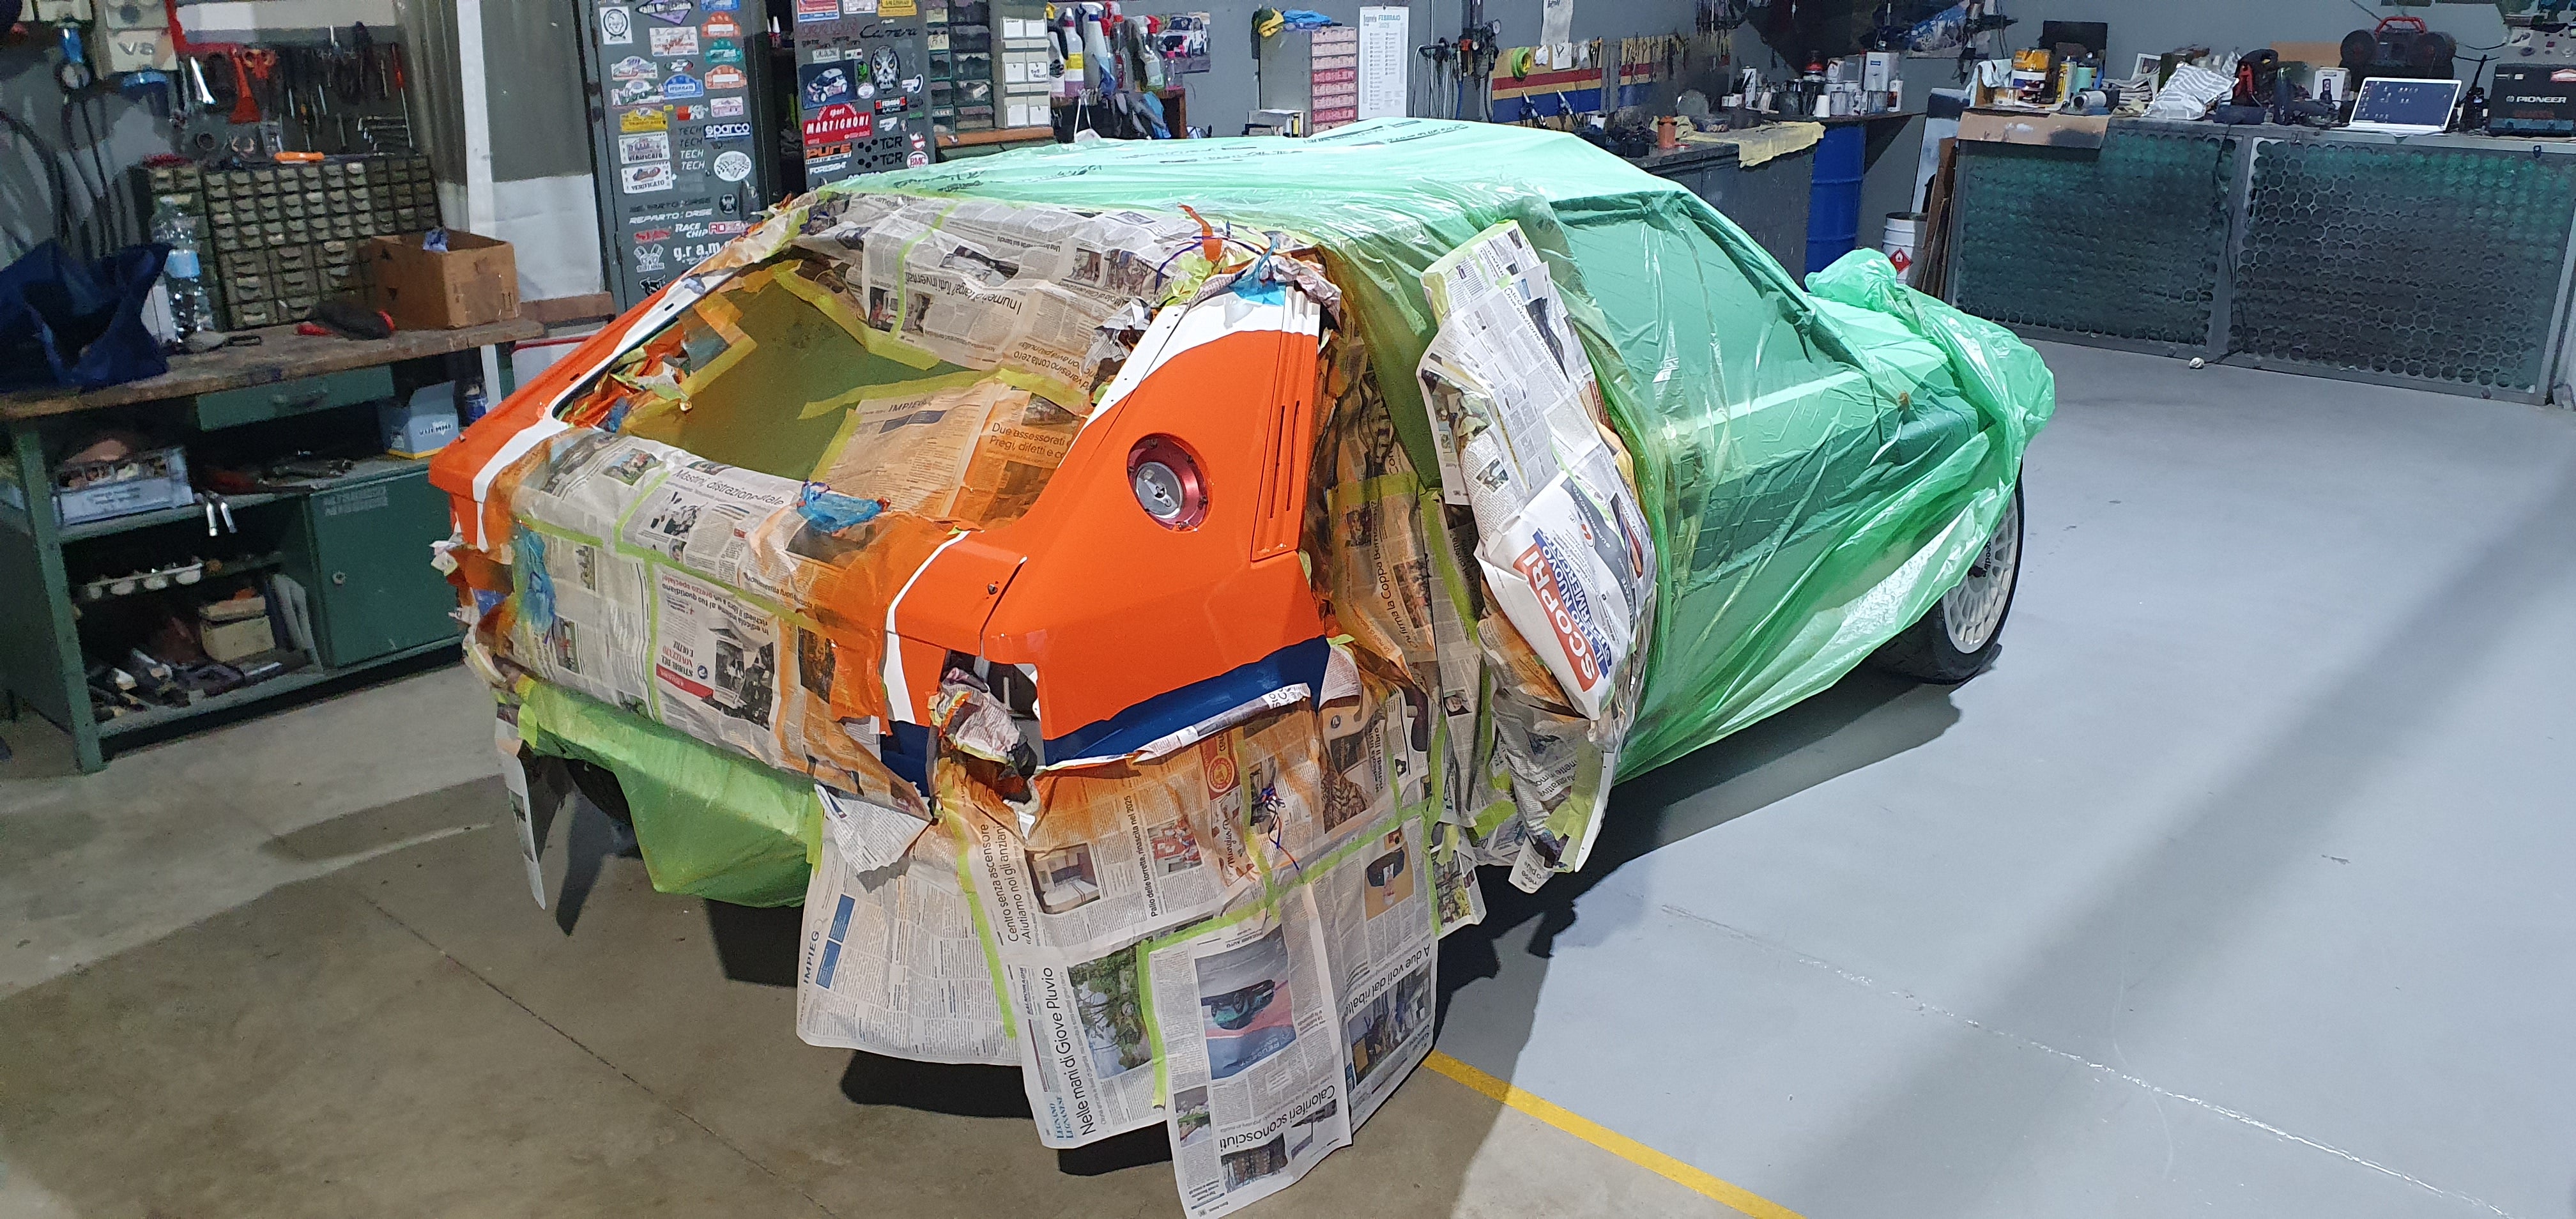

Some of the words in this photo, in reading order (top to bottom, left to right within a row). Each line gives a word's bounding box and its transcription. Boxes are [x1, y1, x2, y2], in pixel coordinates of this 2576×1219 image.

[705, 123, 750, 138] sparco
[806, 115, 870, 135] MARTIGNONI
[680, 139, 702, 147] TECH
[880, 136, 903, 150] TCR
[680, 149, 703, 159] TECH
[880, 151, 903, 165] TCR
[910, 157, 926, 166] BMC
[682, 161, 705, 170] TECH
[629, 212, 680, 224] REPARTO
[675, 222, 702, 233] RACE
[686, 229, 709, 238] CHIP
[1014, 351, 1027, 361] zero
[1027, 353, 1051, 369] conta
[1051, 362, 1081, 384] varesino
[992, 422, 1011, 436] Due
[1013, 429, 1065, 447] assessorati
[990, 436, 1016, 452] Pregi,
[1018, 440, 1045, 456] difetti
[1046, 447, 1054, 456] e
[1376, 561, 1392, 599] Coppa
[1542, 544, 1572, 609] NUOVO
[663, 583, 697, 601] quotidiano
[1387, 598, 1395, 609] la
[1392, 606, 1411, 635] firma
[1523, 551, 1596, 680] SCOPRI
[1571, 609, 1597, 645] TUO
[1593, 644, 1604, 665] IL
[1124, 795, 1135, 815] 2025
[981, 823, 998, 879] ascensore
[996, 824, 1011, 861] anziani
[1133, 827, 1146, 856] rinascita
[1003, 859, 1016, 875] gli
[1140, 854, 1151, 880] torrette,
[994, 878, 1009, 908] senza
[1009, 873, 1020, 893] noi
[1146, 879, 1154, 898] delle
[1149, 896, 1157, 917] Palio
[1002, 909, 1019, 942] Centro
[1015, 893, 1032, 946] «Aiutiamo
[1406, 951, 1422, 967] due
[1423, 943, 1431, 958] A
[1387, 963, 1404, 983] voti
[1041, 967, 1061, 1009] Pluvio
[1372, 976, 1386, 993] dal
[1053, 1012, 1071, 1054] Giove
[1059, 1054, 1076, 1068] di
[1063, 1068, 1085, 1100] mani
[1287, 1085, 1335, 1124] Caloriferi
[1049, 1103, 1064, 1139] LEGNANO
[1057, 1096, 1074, 1139] LEGNANESE
[1075, 1100, 1096, 1136] Nelle
[1220, 1117, 1287, 1153] sconosciuti
